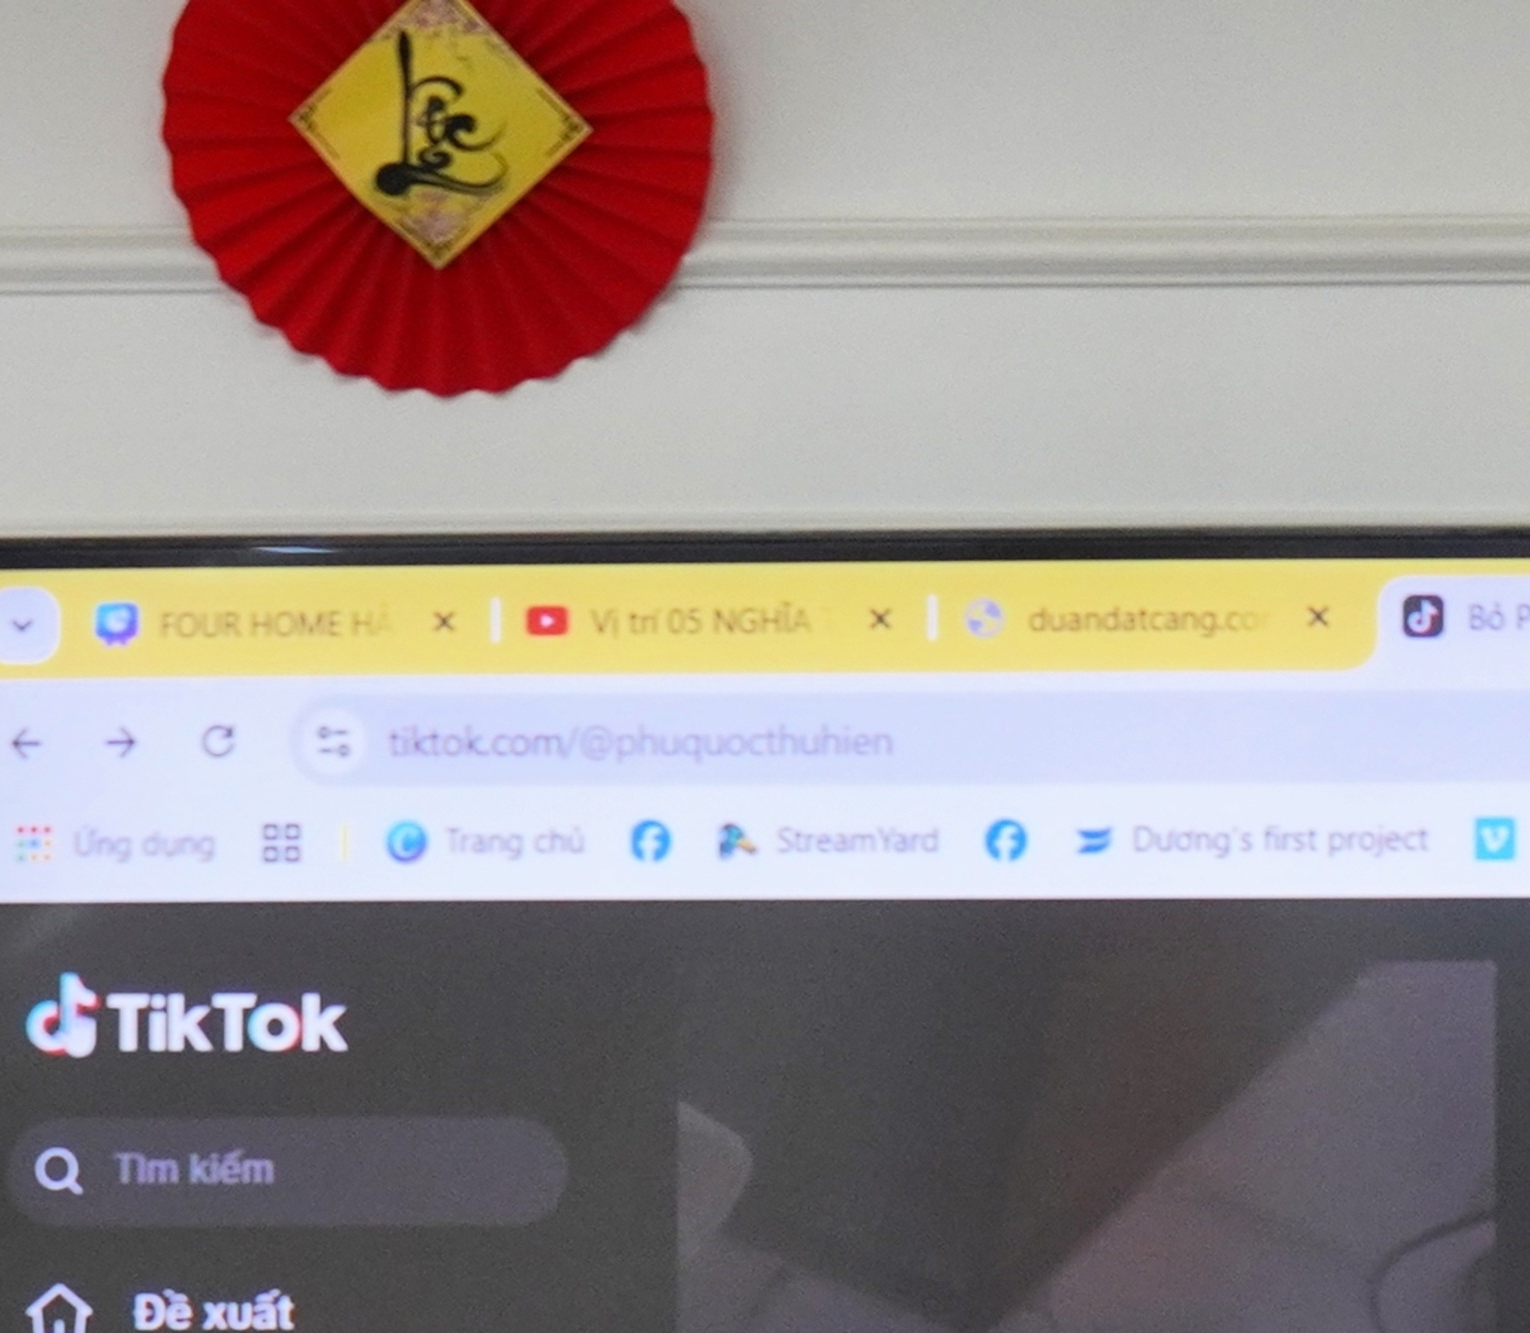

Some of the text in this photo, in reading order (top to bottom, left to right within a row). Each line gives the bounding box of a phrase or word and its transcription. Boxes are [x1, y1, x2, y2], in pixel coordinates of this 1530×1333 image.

[161, 611, 242, 638] FOUR
[251, 611, 342, 638] HOME
[667, 608, 703, 635] 05
[388, 724, 895, 764] tiktok.com/@phuquocthuhien
[142, 829, 216, 863] dụng
[446, 826, 586, 860] Trang chủ
[776, 826, 940, 855] StreamYard
[1264, 825, 1318, 854] first
[1328, 825, 1430, 859] project
[105, 992, 348, 1053] TikTok
[188, 1148, 275, 1186] kiếm
[132, 1287, 295, 1331] Đề xuất
